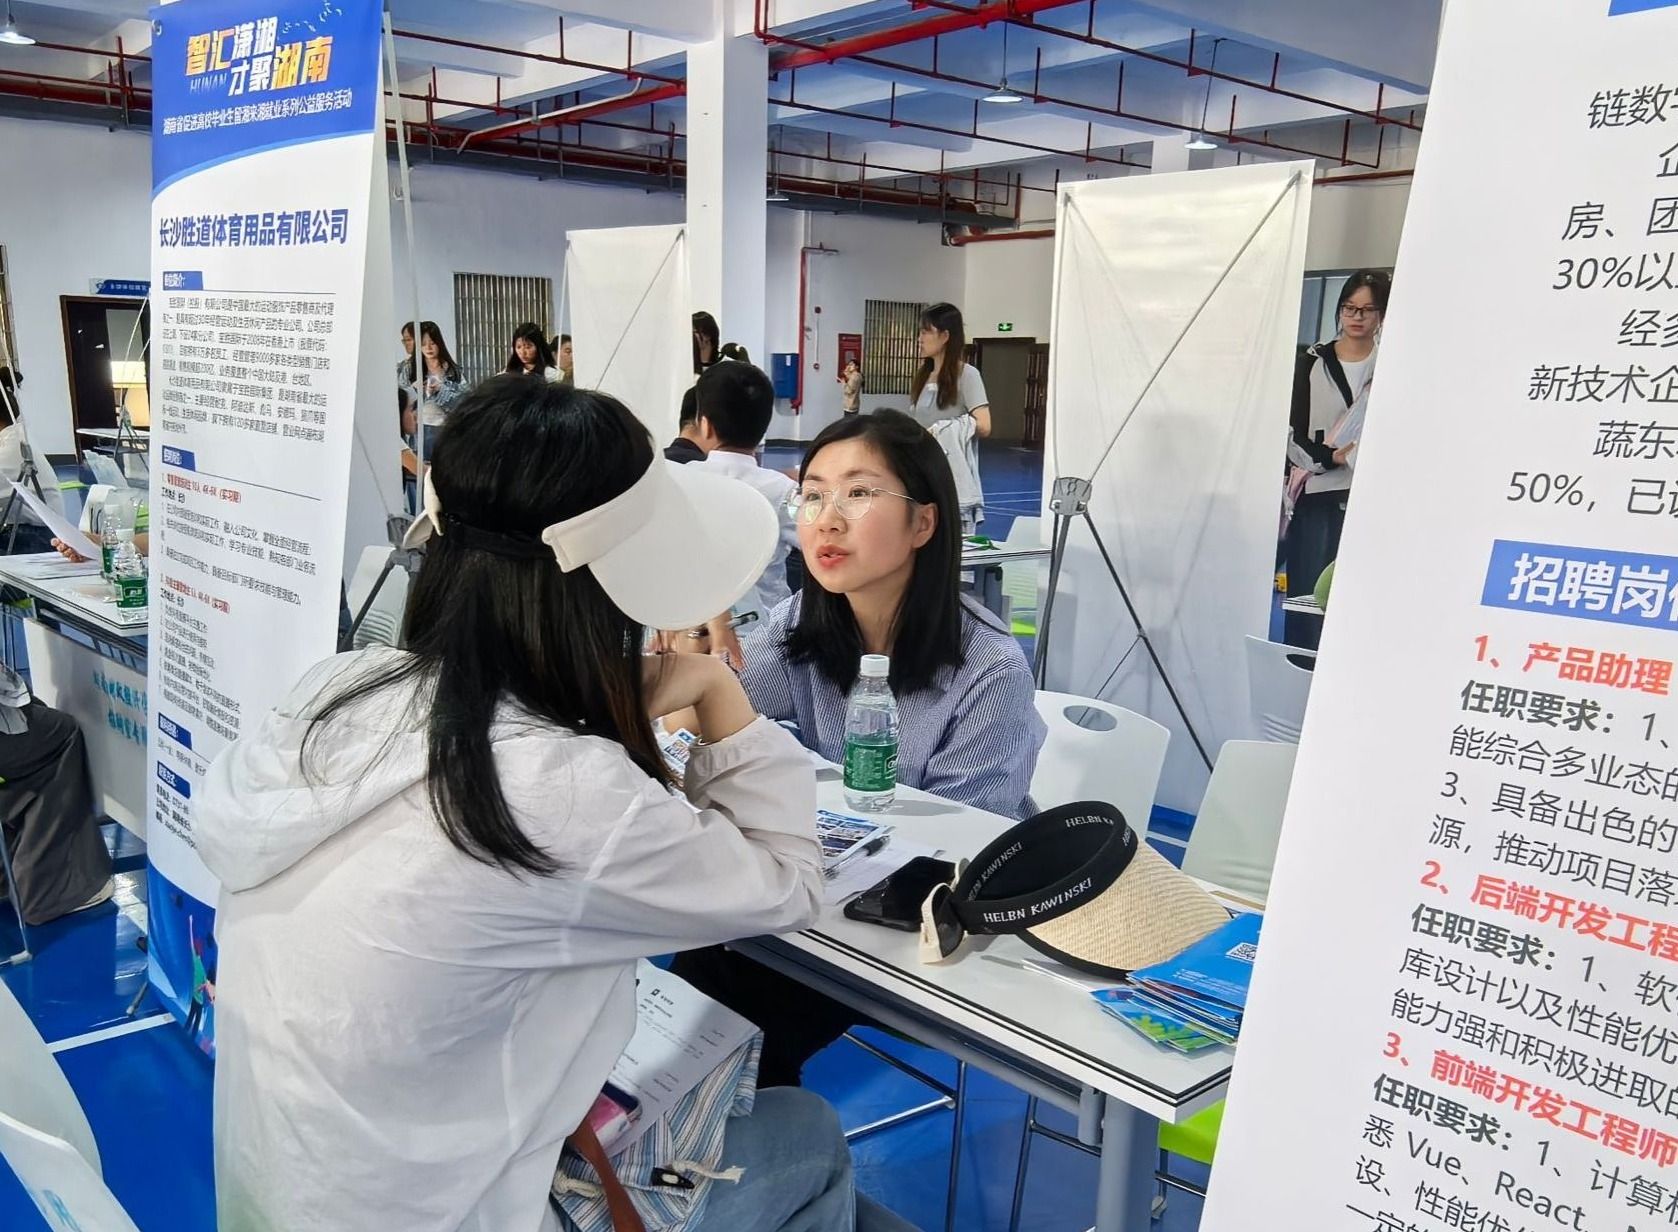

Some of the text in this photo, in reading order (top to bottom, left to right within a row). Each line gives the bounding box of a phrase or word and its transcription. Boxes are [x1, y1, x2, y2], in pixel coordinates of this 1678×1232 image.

[186, 16, 278, 76] 智汇潇湘
[228, 36, 333, 96] 才聚湖南
[1587, 83, 1678, 128] 链数
[159, 209, 349, 248] 长沙胜道体育用品有限公司
[1552, 252, 1678, 291] 30%以
[1593, 420, 1678, 459] 蔬东
[1507, 472, 1678, 518] 50%，已
[1508, 553, 1678, 621] 招聘岗
[1475, 635, 1674, 696] 1、产品助理
[1441, 772, 1678, 853] 3、具备出色的
[1429, 814, 1678, 906] 源，推动项目落
[984, 877, 1092, 923] HELBN KAWINSKI
[1411, 903, 1678, 1016] 任职要求：1、软
[1399, 948, 1678, 1065] 库设计以及性能优
[1383, 1032, 1678, 1168] 3、前端开发工程师
[1373, 1073, 1678, 1224] 任职要求：1、计算
